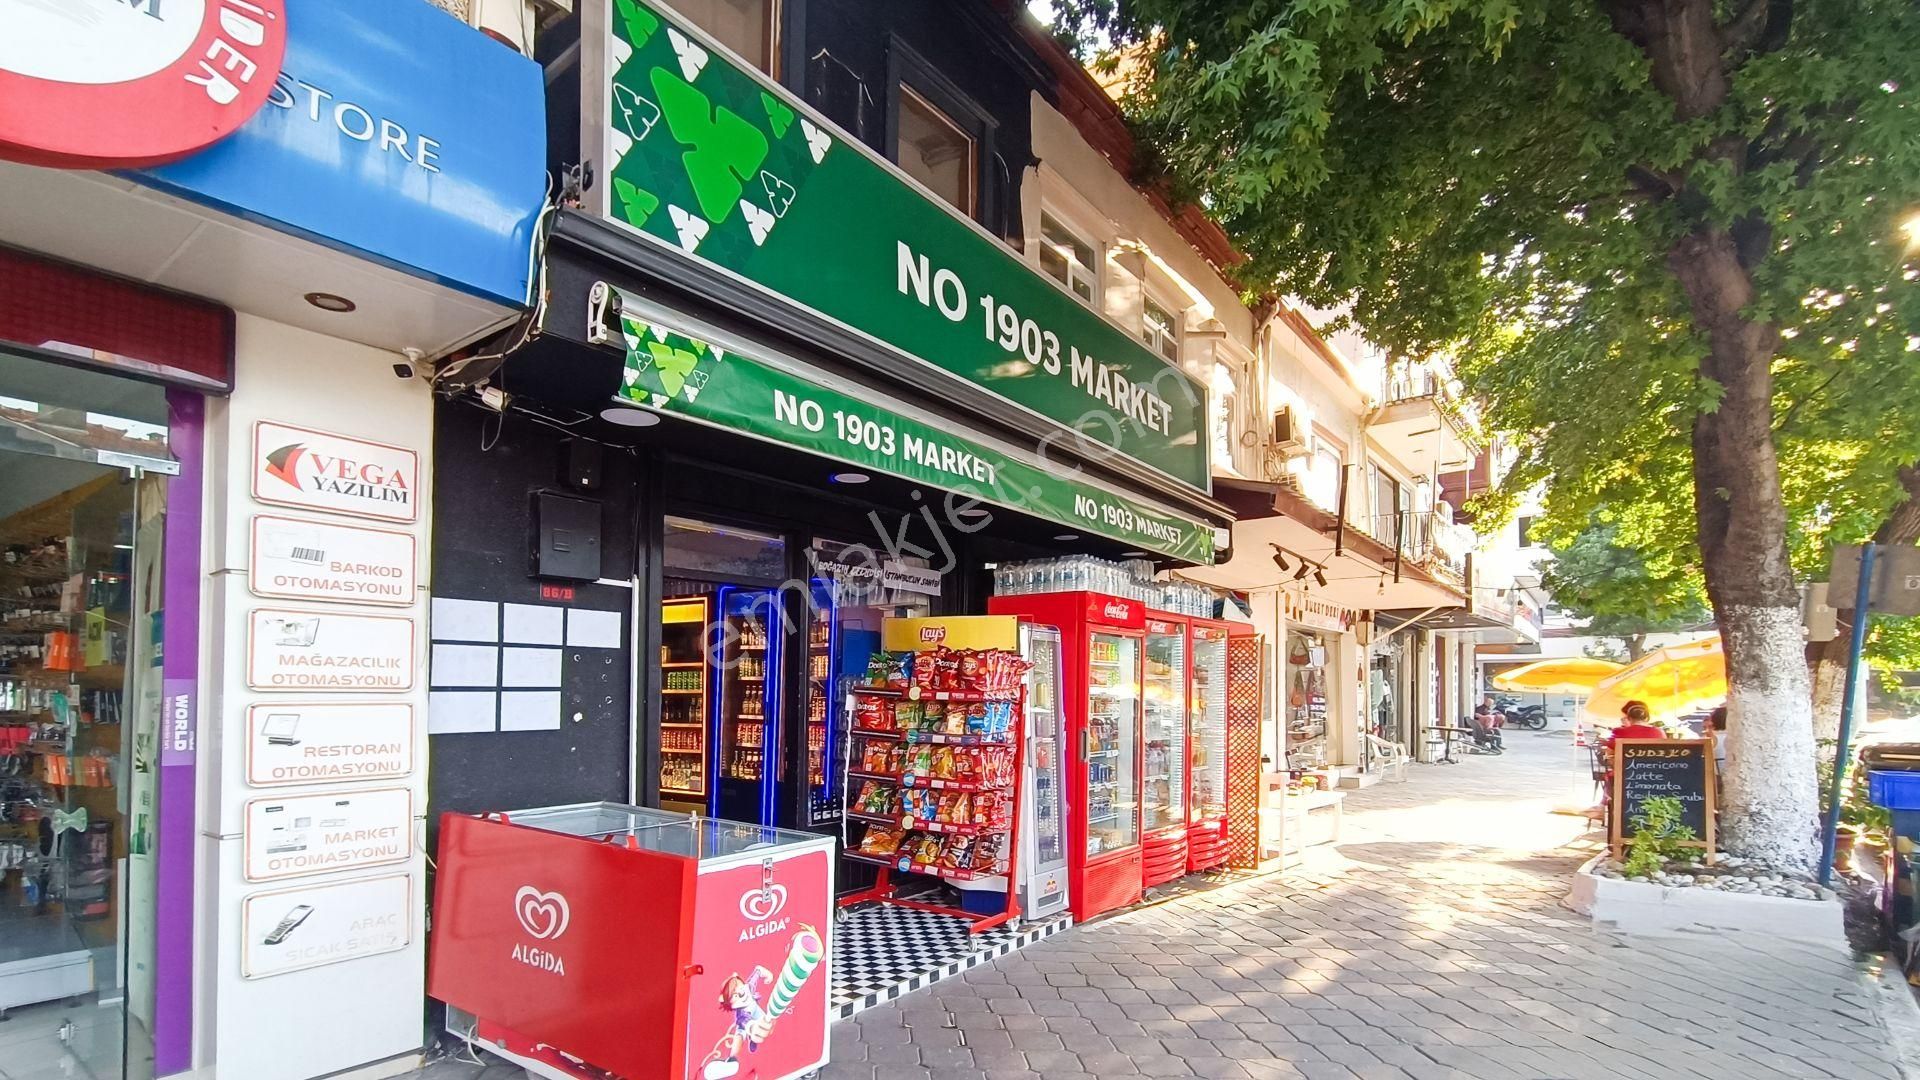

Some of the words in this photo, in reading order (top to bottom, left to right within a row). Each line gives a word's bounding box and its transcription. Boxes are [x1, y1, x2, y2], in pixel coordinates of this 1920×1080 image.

[267, 70, 441, 174] STORE
[897, 240, 968, 323] NO
[981, 294, 1062, 376] 1903
[1070, 345, 1173, 437] MARKET
[774, 389, 824, 433] NO
[833, 411, 896, 456] 1903
[904, 433, 997, 485] MARKET
[309, 453, 408, 489] VEGA
[312, 476, 408, 504] YAZILIM
[1074, 494, 1098, 520] NO
[1101, 503, 1133, 531] 1903
[1136, 513, 1182, 546] MARKET
[330, 561, 403, 579] BARKOD
[274, 575, 403, 597] OTOMASYONU
[278, 652, 401, 669] MAĞAZACILIK
[271, 672, 401, 687] OTOMASYONU
[174, 694, 188, 751] WORLD
[303, 743, 401, 758] RESTORAN
[272, 760, 401, 779] OTOMASYONU
[1625, 759, 1689, 770] Americano
[1625, 771, 1664, 781] Latte
[325, 826, 399, 845] MARKET
[268, 845, 399, 871] OTOMASYONU
